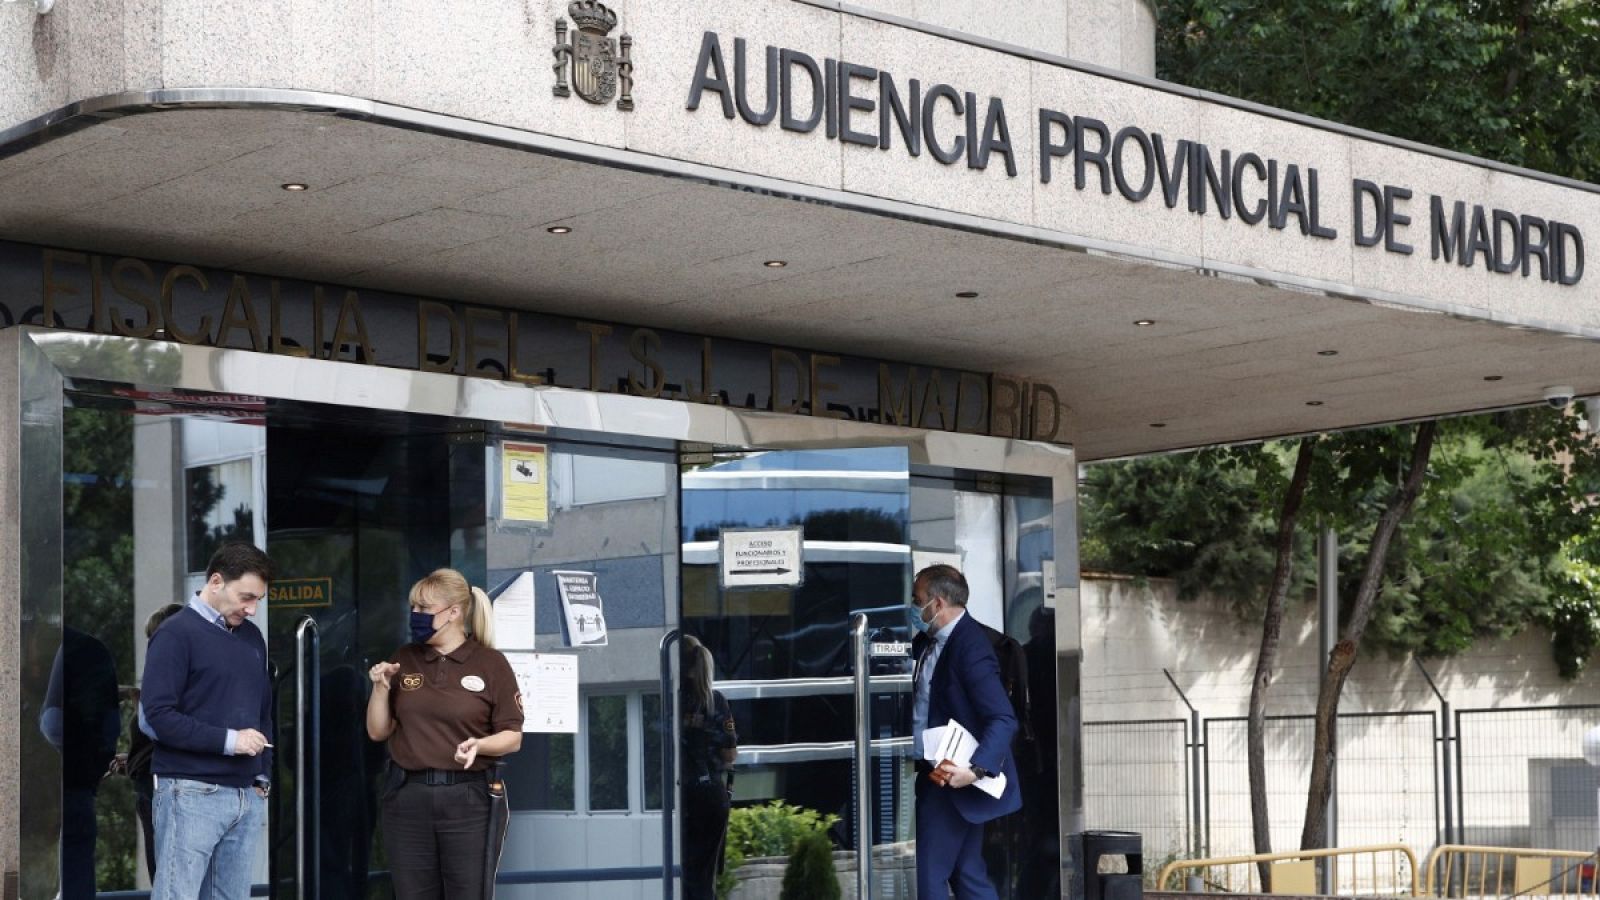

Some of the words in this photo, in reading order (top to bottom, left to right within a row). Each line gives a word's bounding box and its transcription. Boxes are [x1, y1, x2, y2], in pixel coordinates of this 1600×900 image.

[685, 31, 1017, 178] AUDIENCIA
[1039, 108, 1337, 240] PROVINCIAL
[1353, 178, 1414, 255] DE
[1430, 195, 1585, 286] MADRID
[42, 248, 376, 366] FISCALIA
[417, 300, 543, 385] DEL
[771, 347, 841, 418] DE
[878, 361, 1061, 442] MADRID
[269, 585, 324, 600] SALIDA
